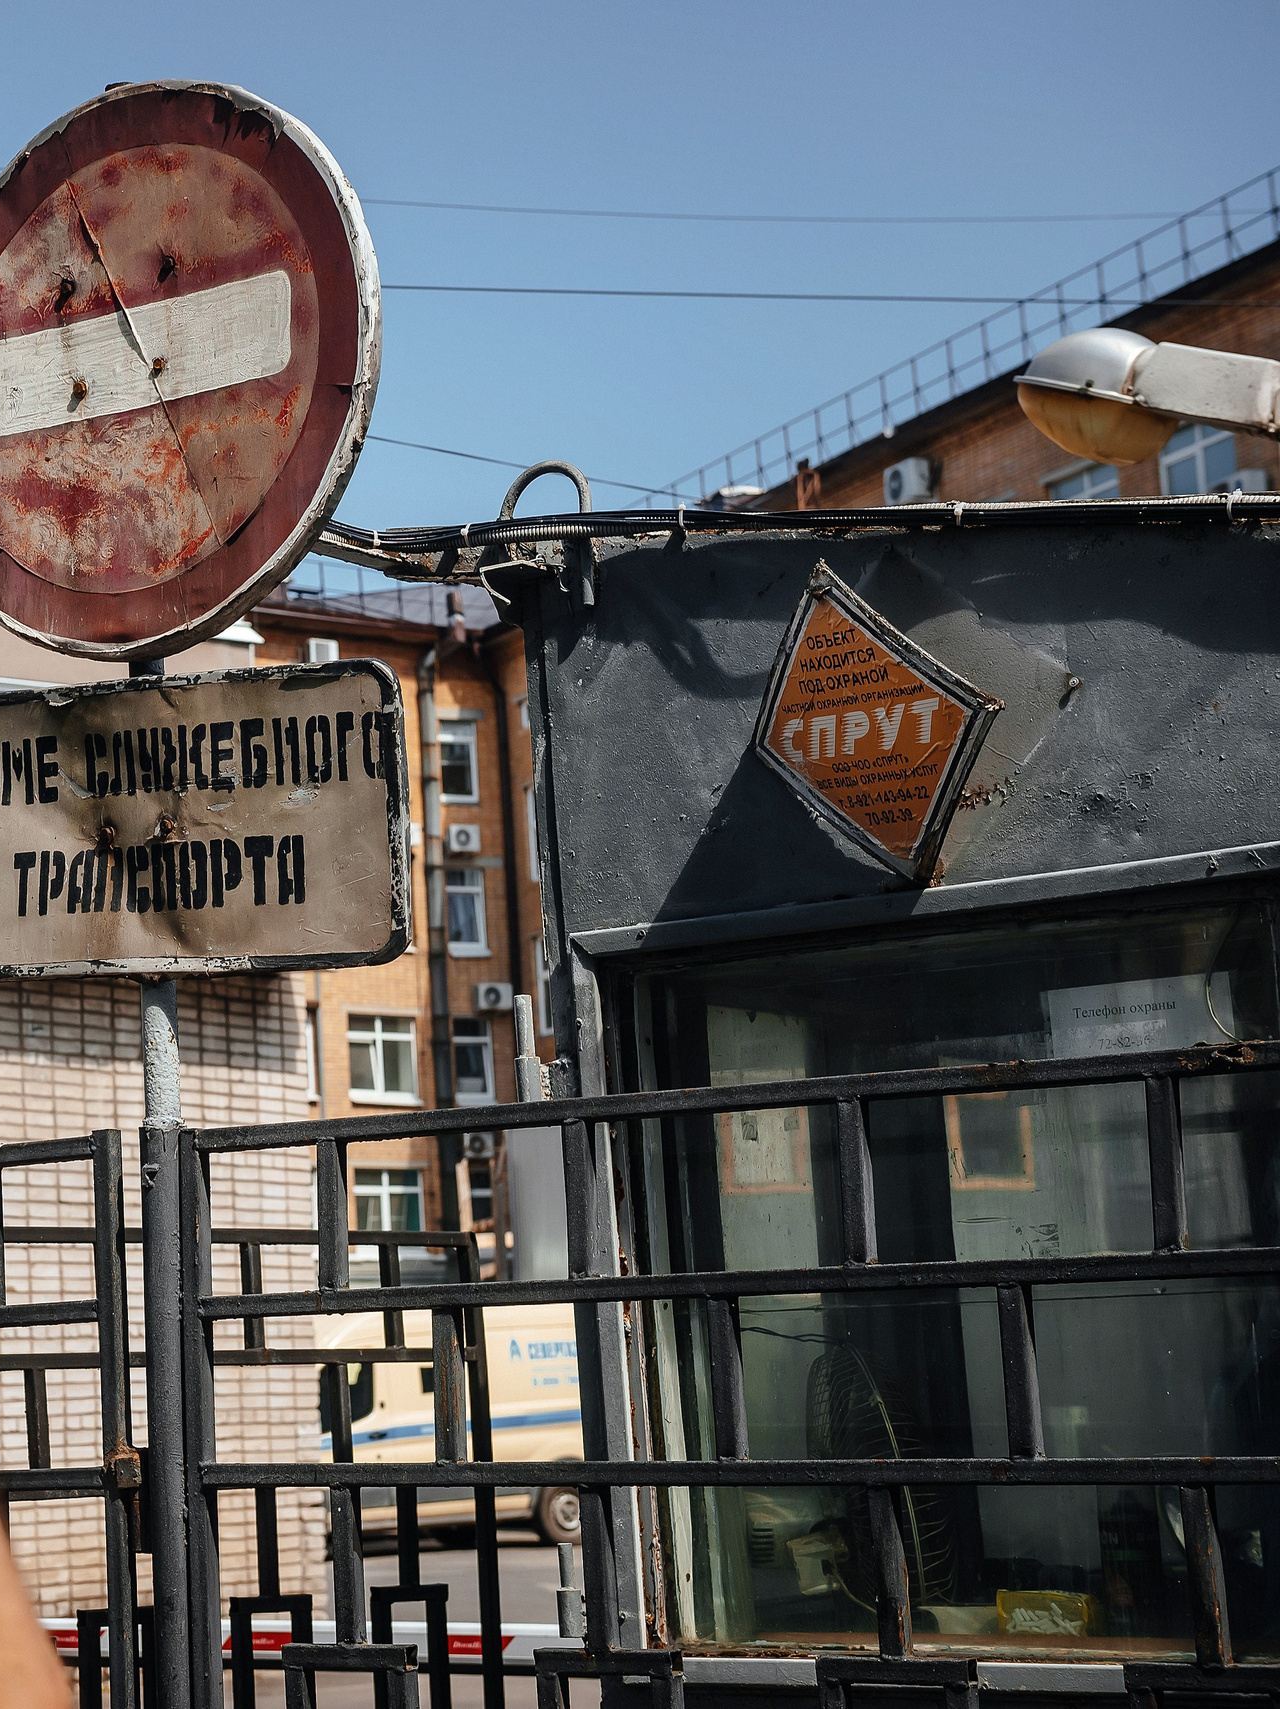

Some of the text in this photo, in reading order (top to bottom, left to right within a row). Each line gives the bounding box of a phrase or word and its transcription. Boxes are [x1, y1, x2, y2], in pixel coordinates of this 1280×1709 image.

[806, 628, 857, 651] ОБЪЕКТ
[799, 647, 876, 673] НАХОДИТСЯ
[798, 664, 890, 695] ПОД ОХРАНОЙ
[781, 683, 926, 715] ЧАСТНОЙ ОХРАННОЙ ОРГАНИЗАЦИИ
[778, 697, 940, 763] СПРУТ
[83, 711, 388, 798] СЛУЖЕБНОГО
[831, 762, 851, 774] ООО
[851, 759, 871, 771] ЧОО
[816, 763, 940, 790] ВСЕ ВИДЫ ОХРАННЫХ УСЛУГ
[865, 807, 915, 826] 70-92-39
[13, 835, 306, 917] ТРАНСПОРТА
[1072, 1001, 1177, 1019] Телефон охраны
